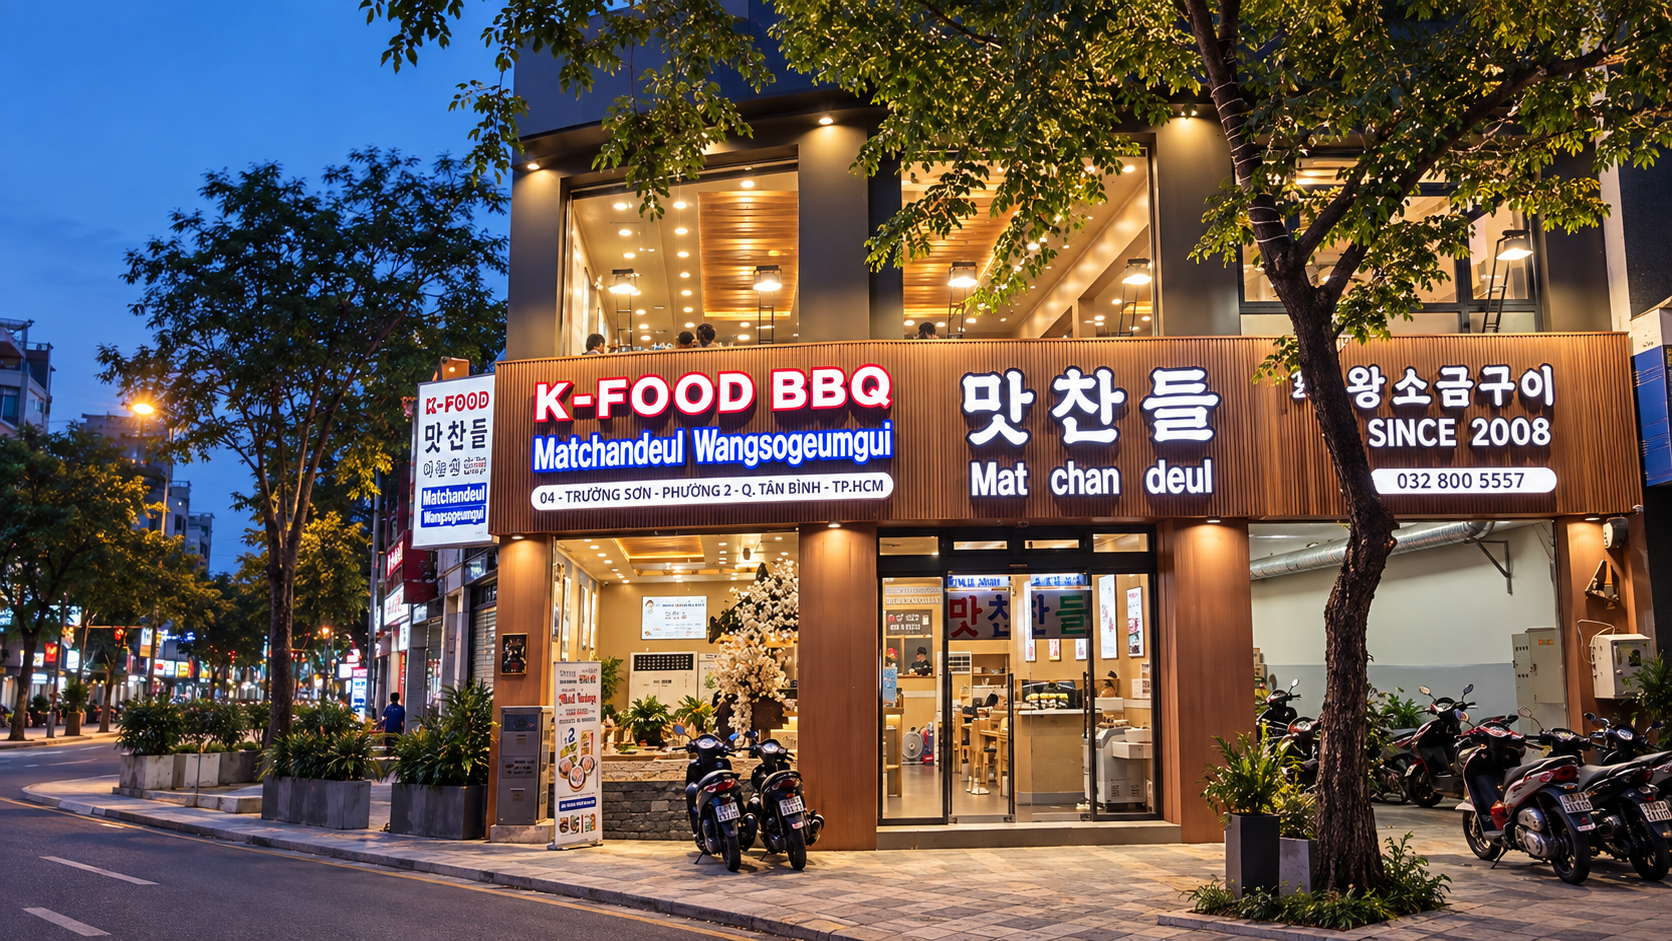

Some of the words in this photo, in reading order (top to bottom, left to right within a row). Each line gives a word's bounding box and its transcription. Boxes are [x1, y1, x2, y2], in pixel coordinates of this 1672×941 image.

[426, 391, 489, 415] K-FOOD
[534, 370, 756, 422] K-FOOD
[771, 363, 893, 411] BBQ
[1367, 418, 1457, 447] SINCE
[1471, 417, 1551, 446] 2008
[533, 429, 684, 471] Matchandeul
[693, 421, 892, 467] Wangsogeumgui
[970, 461, 1029, 497] Mat
[1050, 460, 1121, 496] chan
[1145, 458, 1213, 495] deul
[1397, 472, 1431, 489] 032
[1437, 472, 1472, 489] 800
[1479, 472, 1525, 489] 5557
[423, 485, 485, 506] Matchandeul
[540, 492, 555, 504] 04
[565, 487, 620, 503] TRƯỜNG
[624, 486, 651, 500] SƠN
[662, 483, 721, 499] PHƯỜNG
[723, 484, 732, 497] 2
[742, 483, 756, 497] Q.
[758, 480, 785, 495] TÂN
[788, 479, 821, 494] BÌNH
[832, 479, 884, 493] TP.HCM
